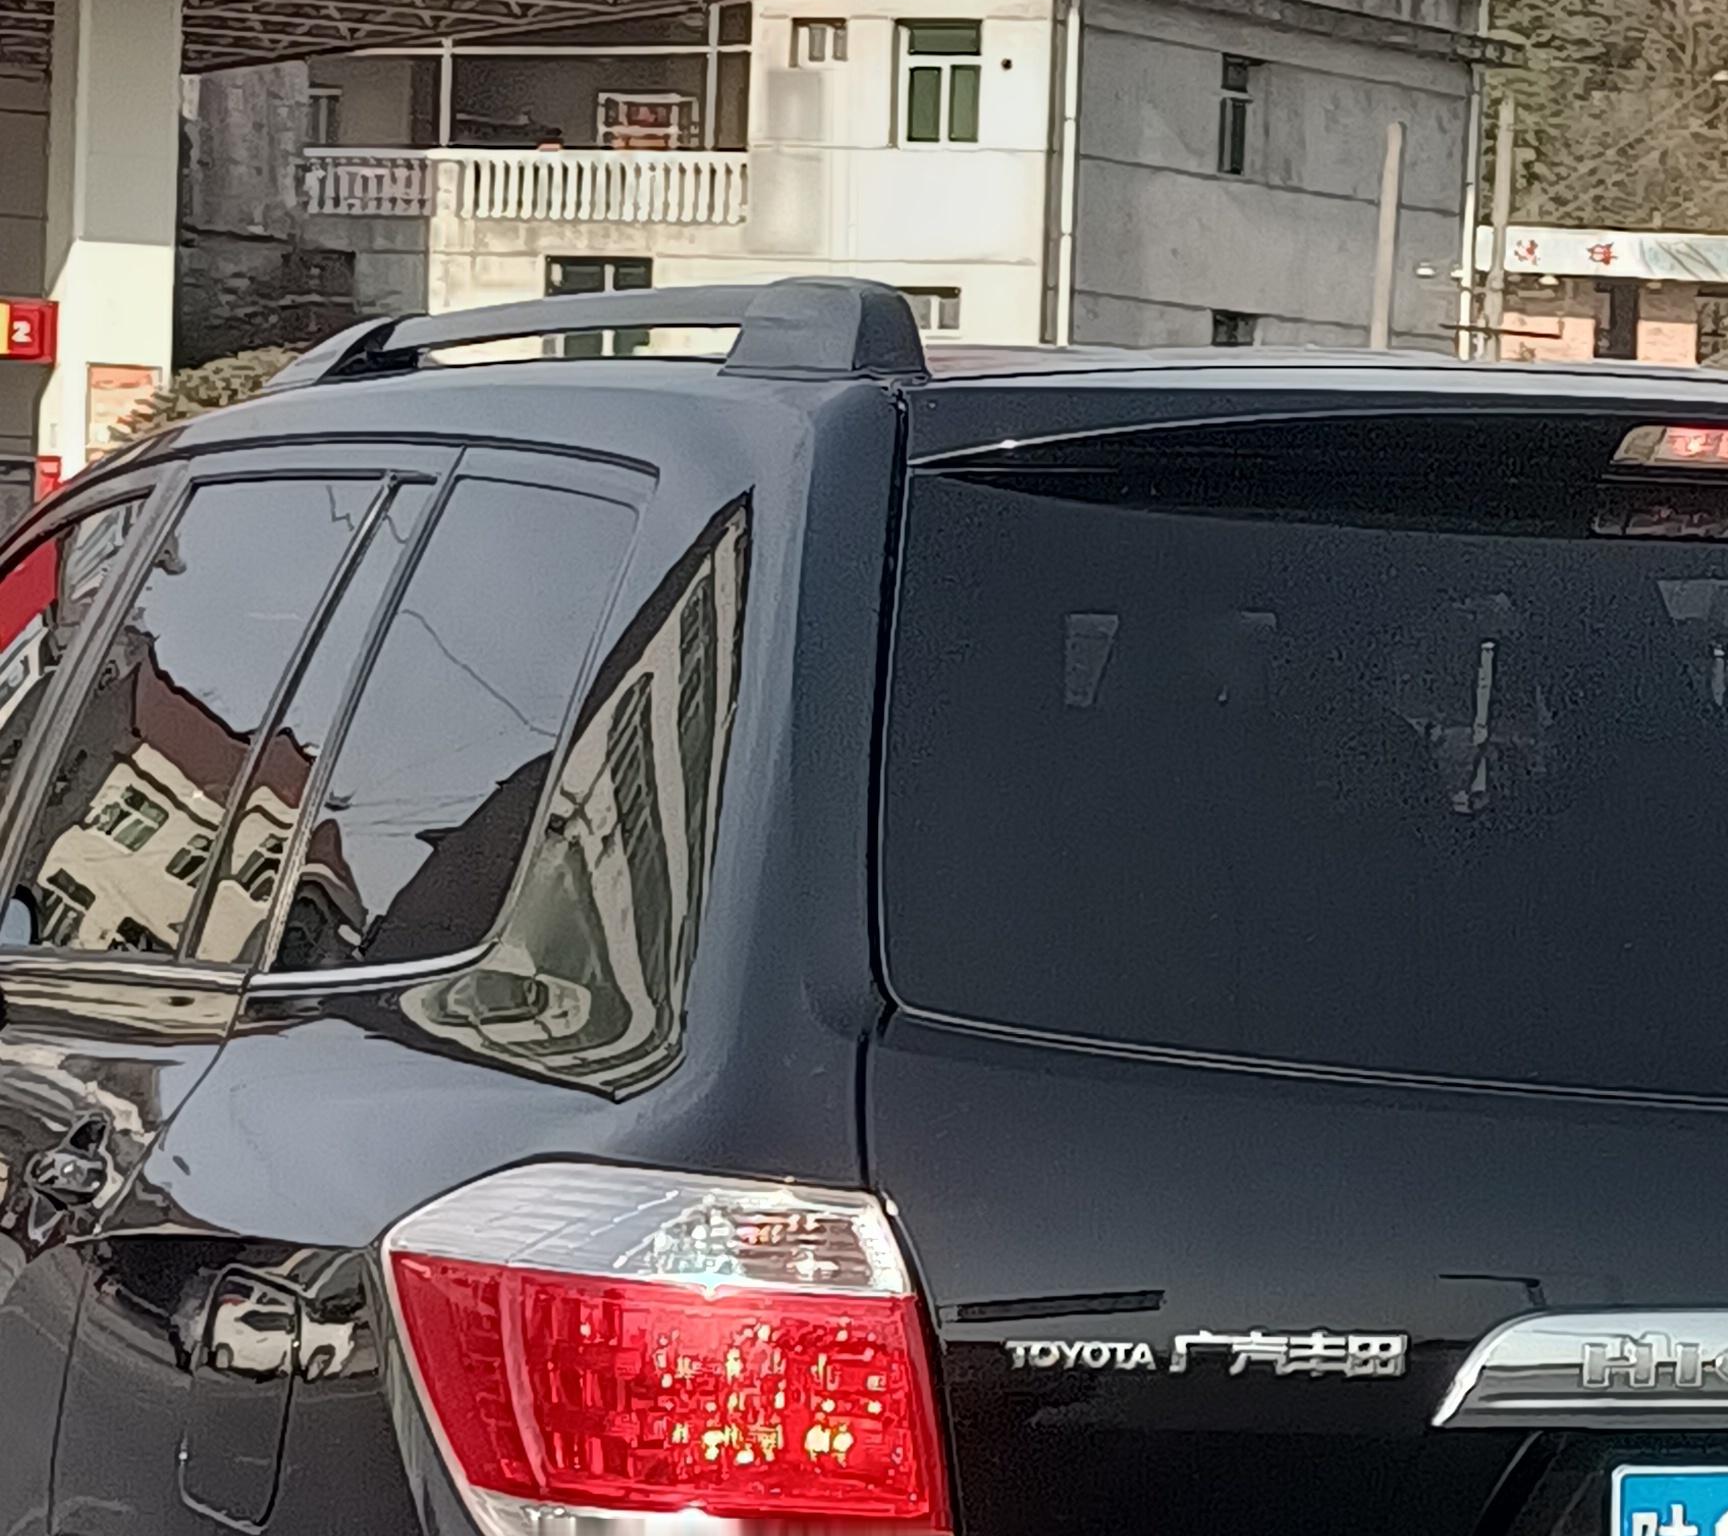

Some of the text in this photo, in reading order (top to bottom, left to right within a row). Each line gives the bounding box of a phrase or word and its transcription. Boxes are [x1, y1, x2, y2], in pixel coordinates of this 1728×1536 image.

[11, 320, 33, 343] 2
[1004, 1329, 1409, 1378] TOYOTA 广汽丰田
